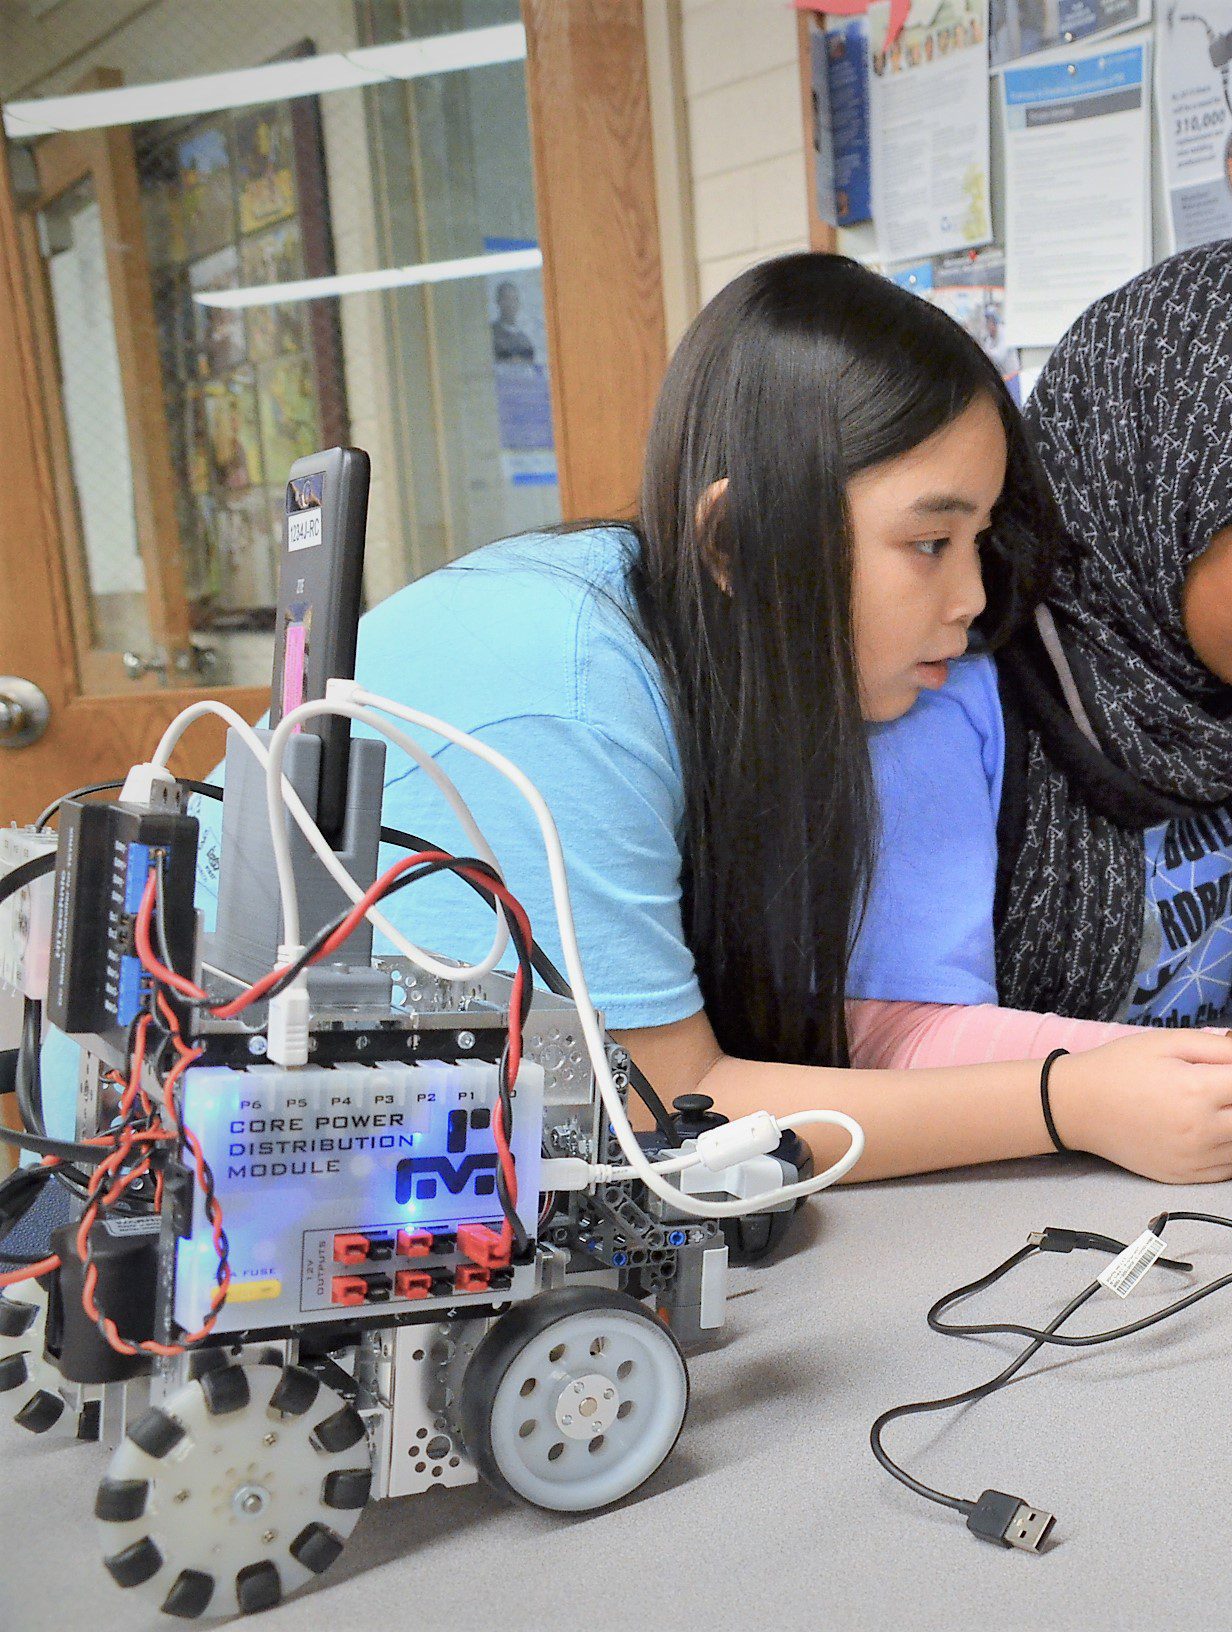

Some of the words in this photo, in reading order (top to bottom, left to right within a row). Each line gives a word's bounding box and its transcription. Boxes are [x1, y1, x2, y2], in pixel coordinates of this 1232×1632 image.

[331, 1096, 352, 1107] P4
[374, 1094, 395, 1105] P3
[417, 1092, 436, 1103] P2
[458, 1091, 475, 1101] P1
[241, 1100, 262, 1110] P6
[286, 1098, 308, 1108] P5
[229, 1118, 303, 1134] CORE
[315, 1113, 405, 1130] POWER
[229, 1134, 415, 1157] DISTRIBUTION
[228, 1159, 341, 1179] MODULE
[242, 1267, 277, 1278] FUSE
[306, 1259, 314, 1281] 12V
[317, 1240, 326, 1296] OUTPUTS
